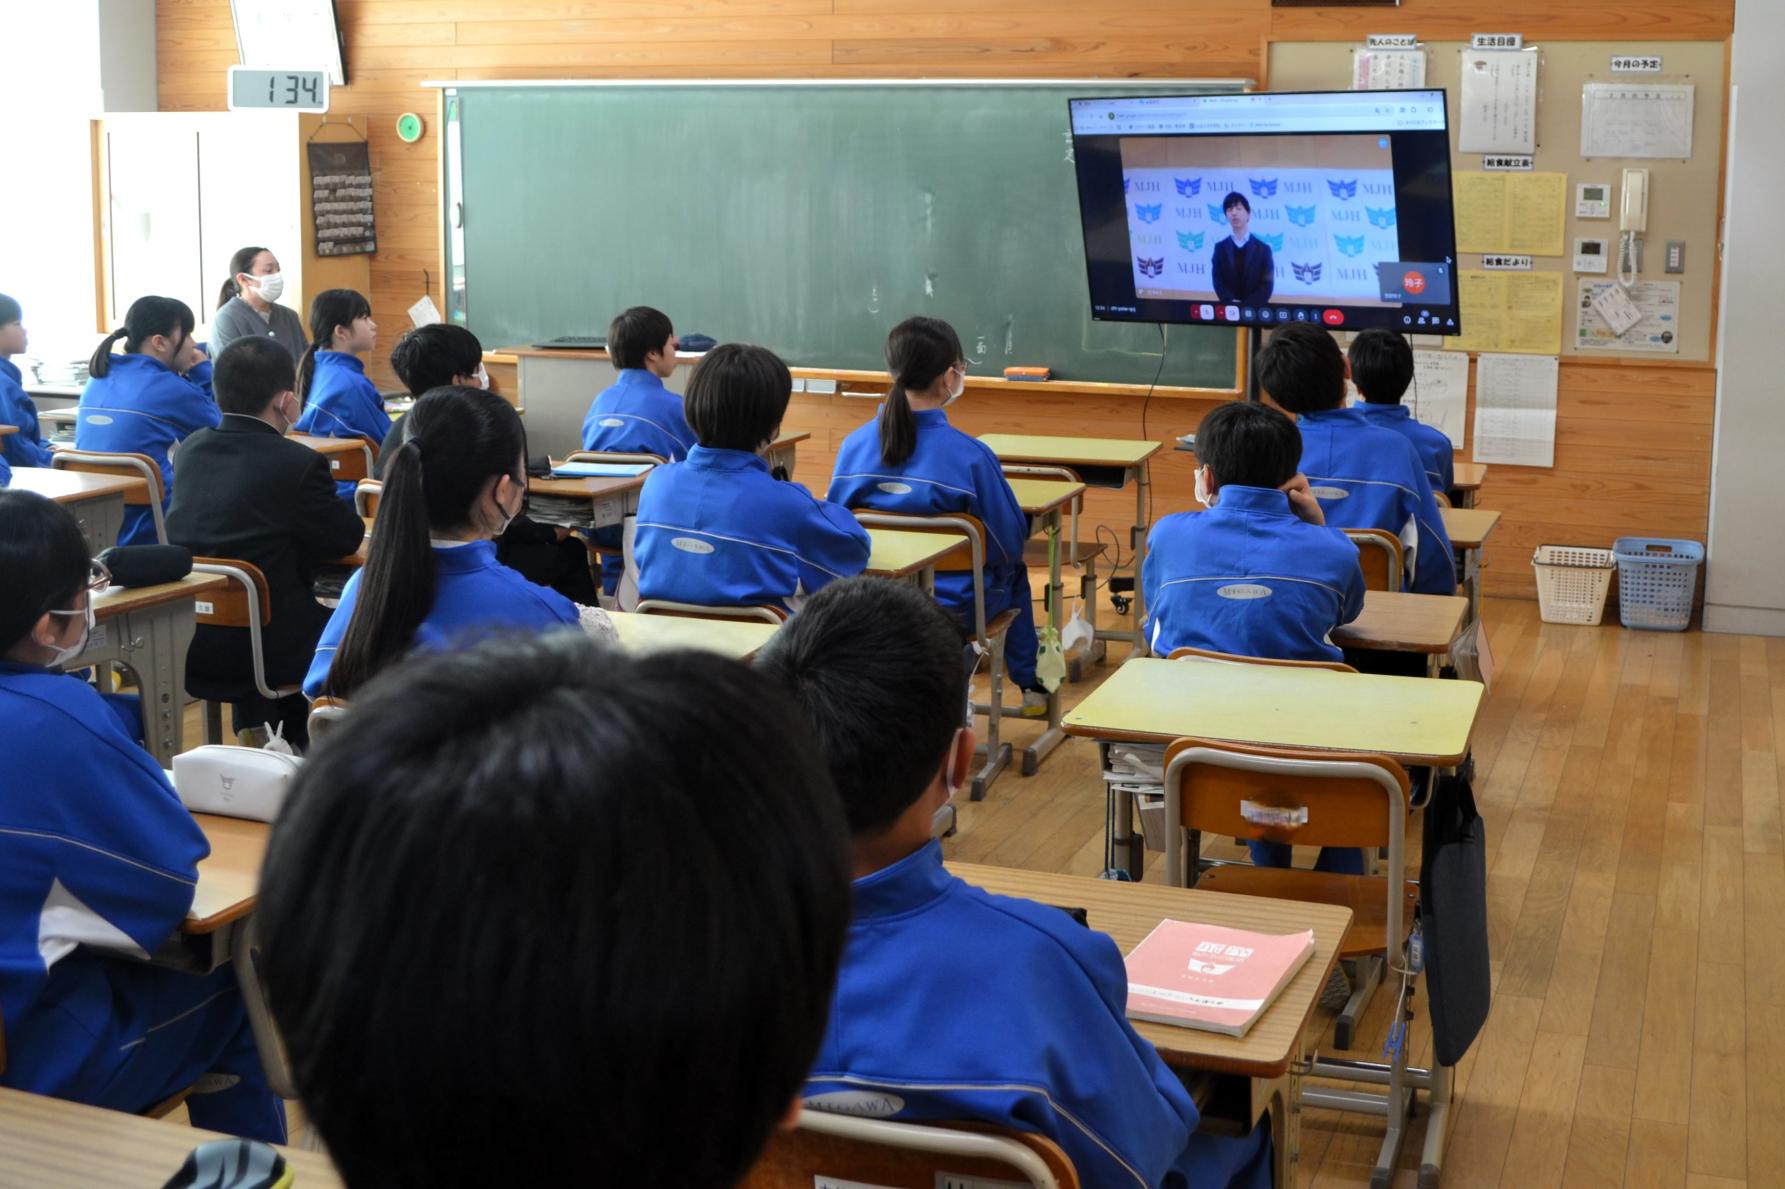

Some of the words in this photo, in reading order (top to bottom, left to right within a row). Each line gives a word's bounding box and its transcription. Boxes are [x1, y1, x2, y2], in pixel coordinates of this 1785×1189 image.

[1477, 36, 1516, 47] 生活目標
[1613, 59, 1659, 69] 今月の予定
[1486, 158, 1530, 167] 給食献立表
[1134, 182, 1160, 192] MJH
[1206, 182, 1234, 193] MJH
[1283, 182, 1312, 193] MJH
[1361, 183, 1393, 195] MJH
[1175, 207, 1202, 219] MJH
[1330, 209, 1360, 222] MJH
[1486, 258, 1528, 267] 給食だより
[1177, 262, 1205, 275] MJH
[1337, 268, 1367, 281] MJH
